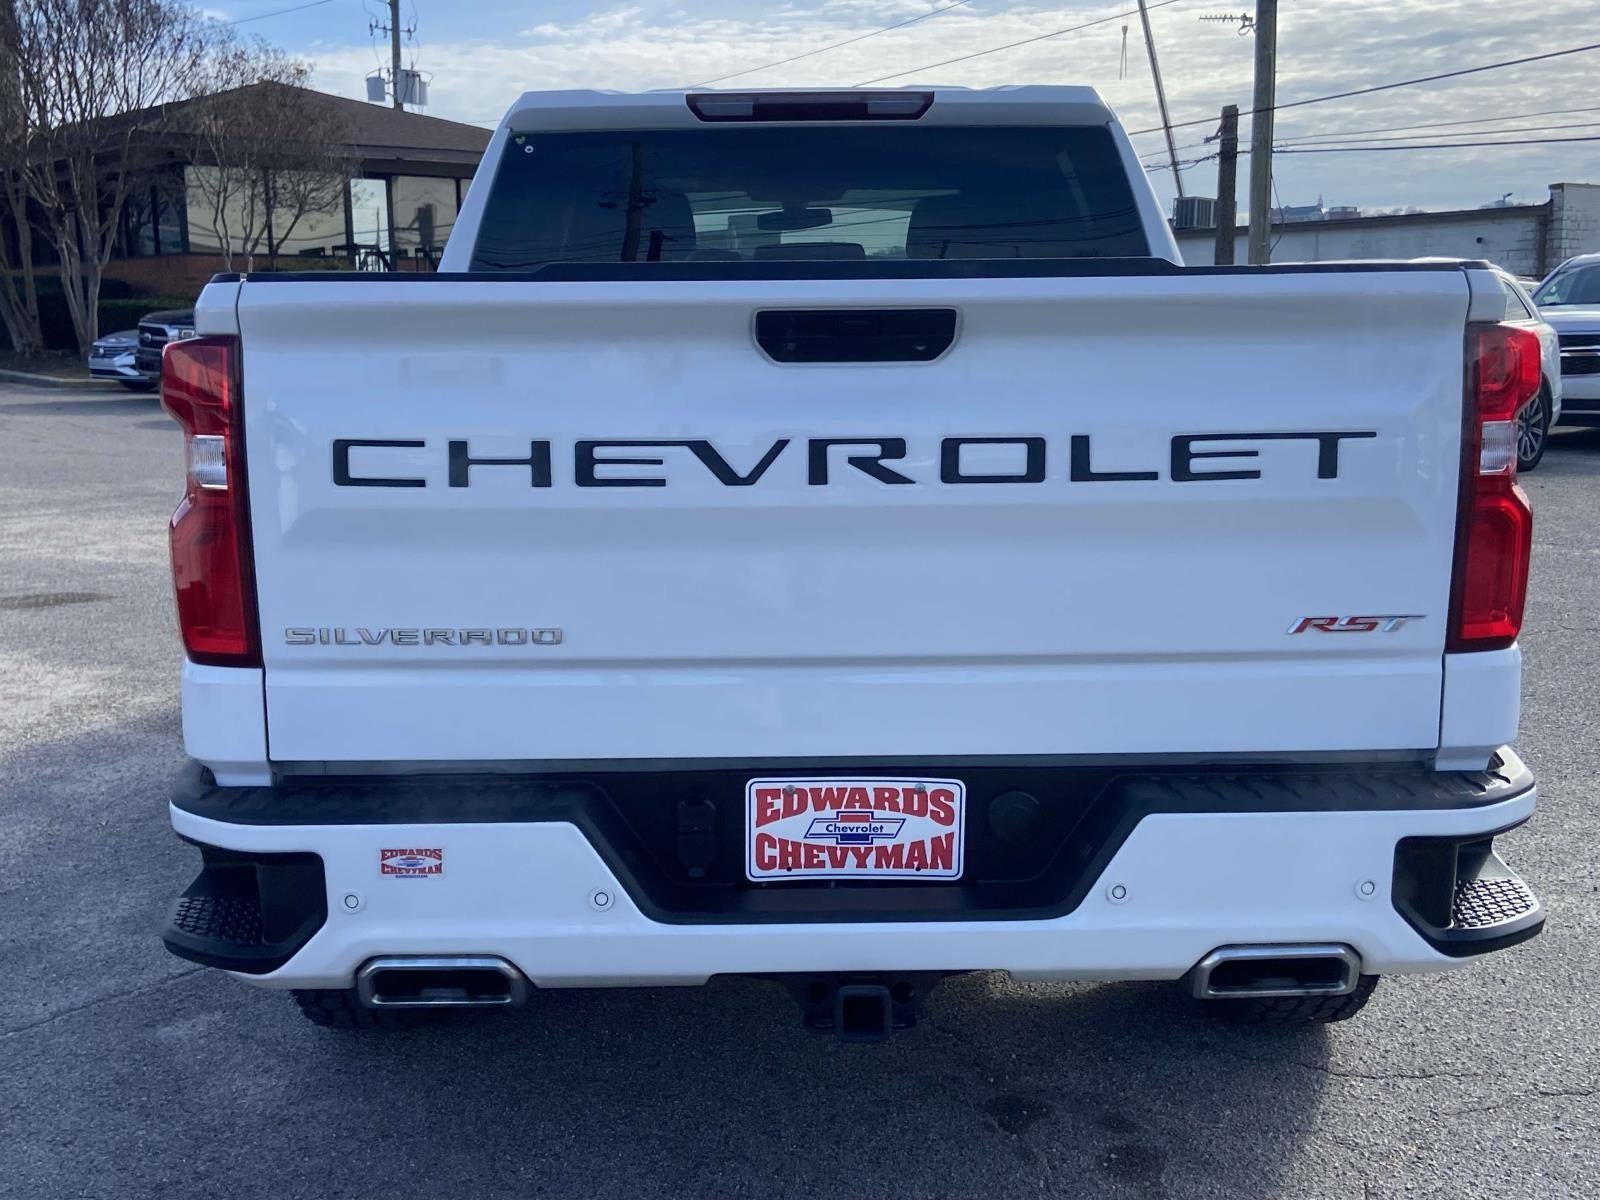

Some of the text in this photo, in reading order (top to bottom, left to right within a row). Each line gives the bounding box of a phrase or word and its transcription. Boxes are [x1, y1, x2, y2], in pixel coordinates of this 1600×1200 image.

[333, 431, 1377, 487] CHEVROLET
[1286, 614, 1427, 634] RST
[284, 627, 563, 646] SILVERADO
[755, 787, 955, 828] EDWARDS
[825, 823, 884, 833] Chevrolet
[380, 848, 442, 861] EDWARDS
[755, 832, 955, 871] CHEVYMAN
[381, 862, 442, 875] CHEVYMAN
